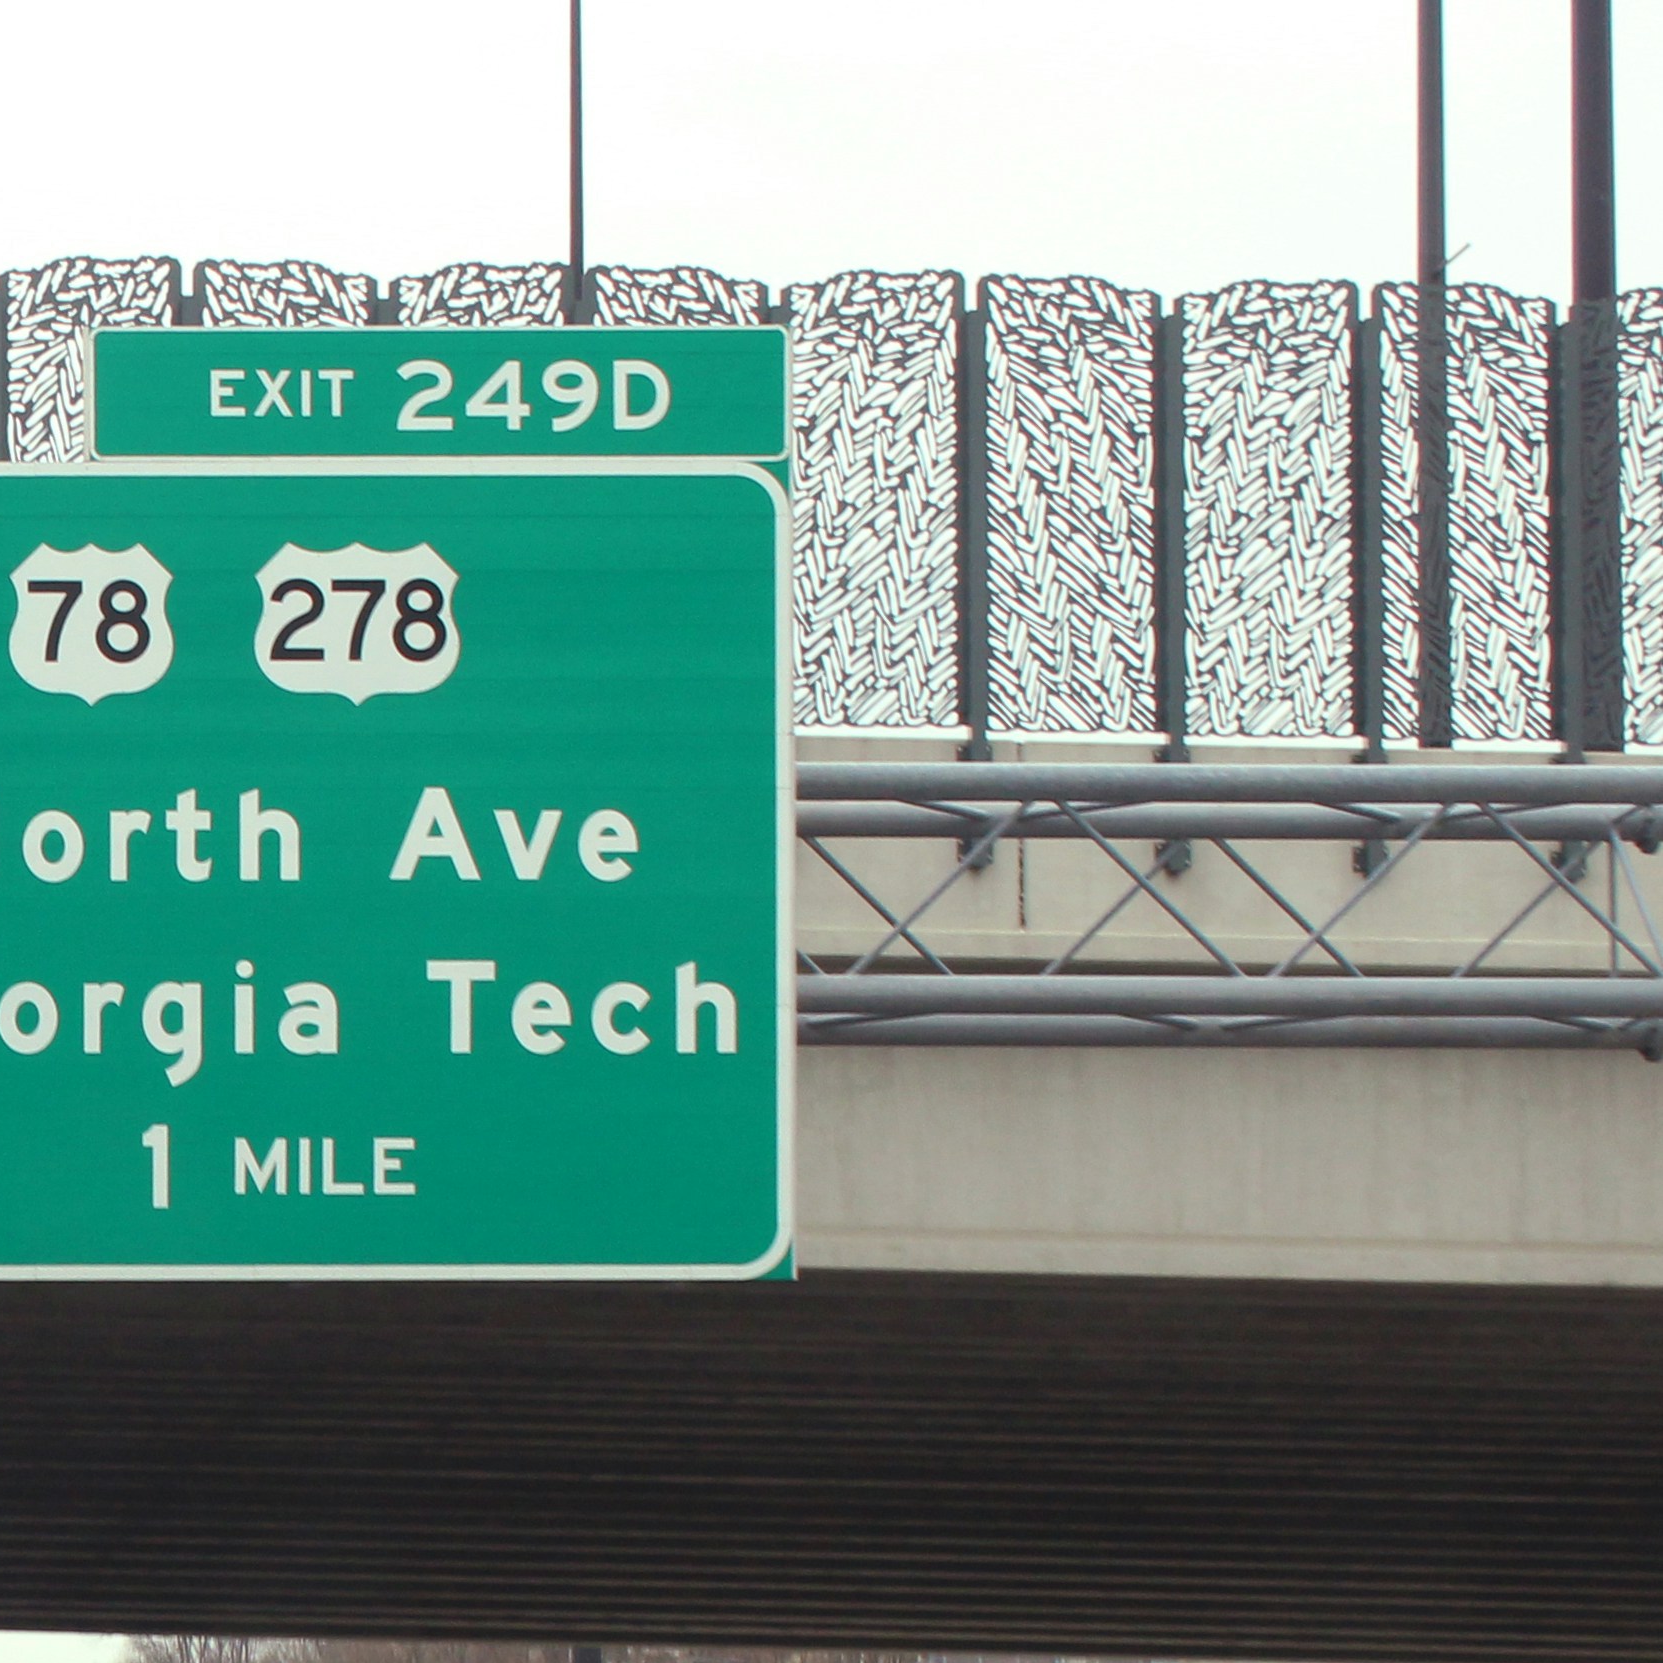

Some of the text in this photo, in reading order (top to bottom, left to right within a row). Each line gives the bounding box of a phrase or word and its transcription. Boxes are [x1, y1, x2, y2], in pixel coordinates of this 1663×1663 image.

[211, 360, 671, 431] EXIT 249D
[26, 578, 152, 663] 78
[269, 578, 448, 663] 278
[390, 787, 639, 881] Ave
[427, 960, 737, 1054] Tech
[142, 1124, 416, 1209] 1 MILE
